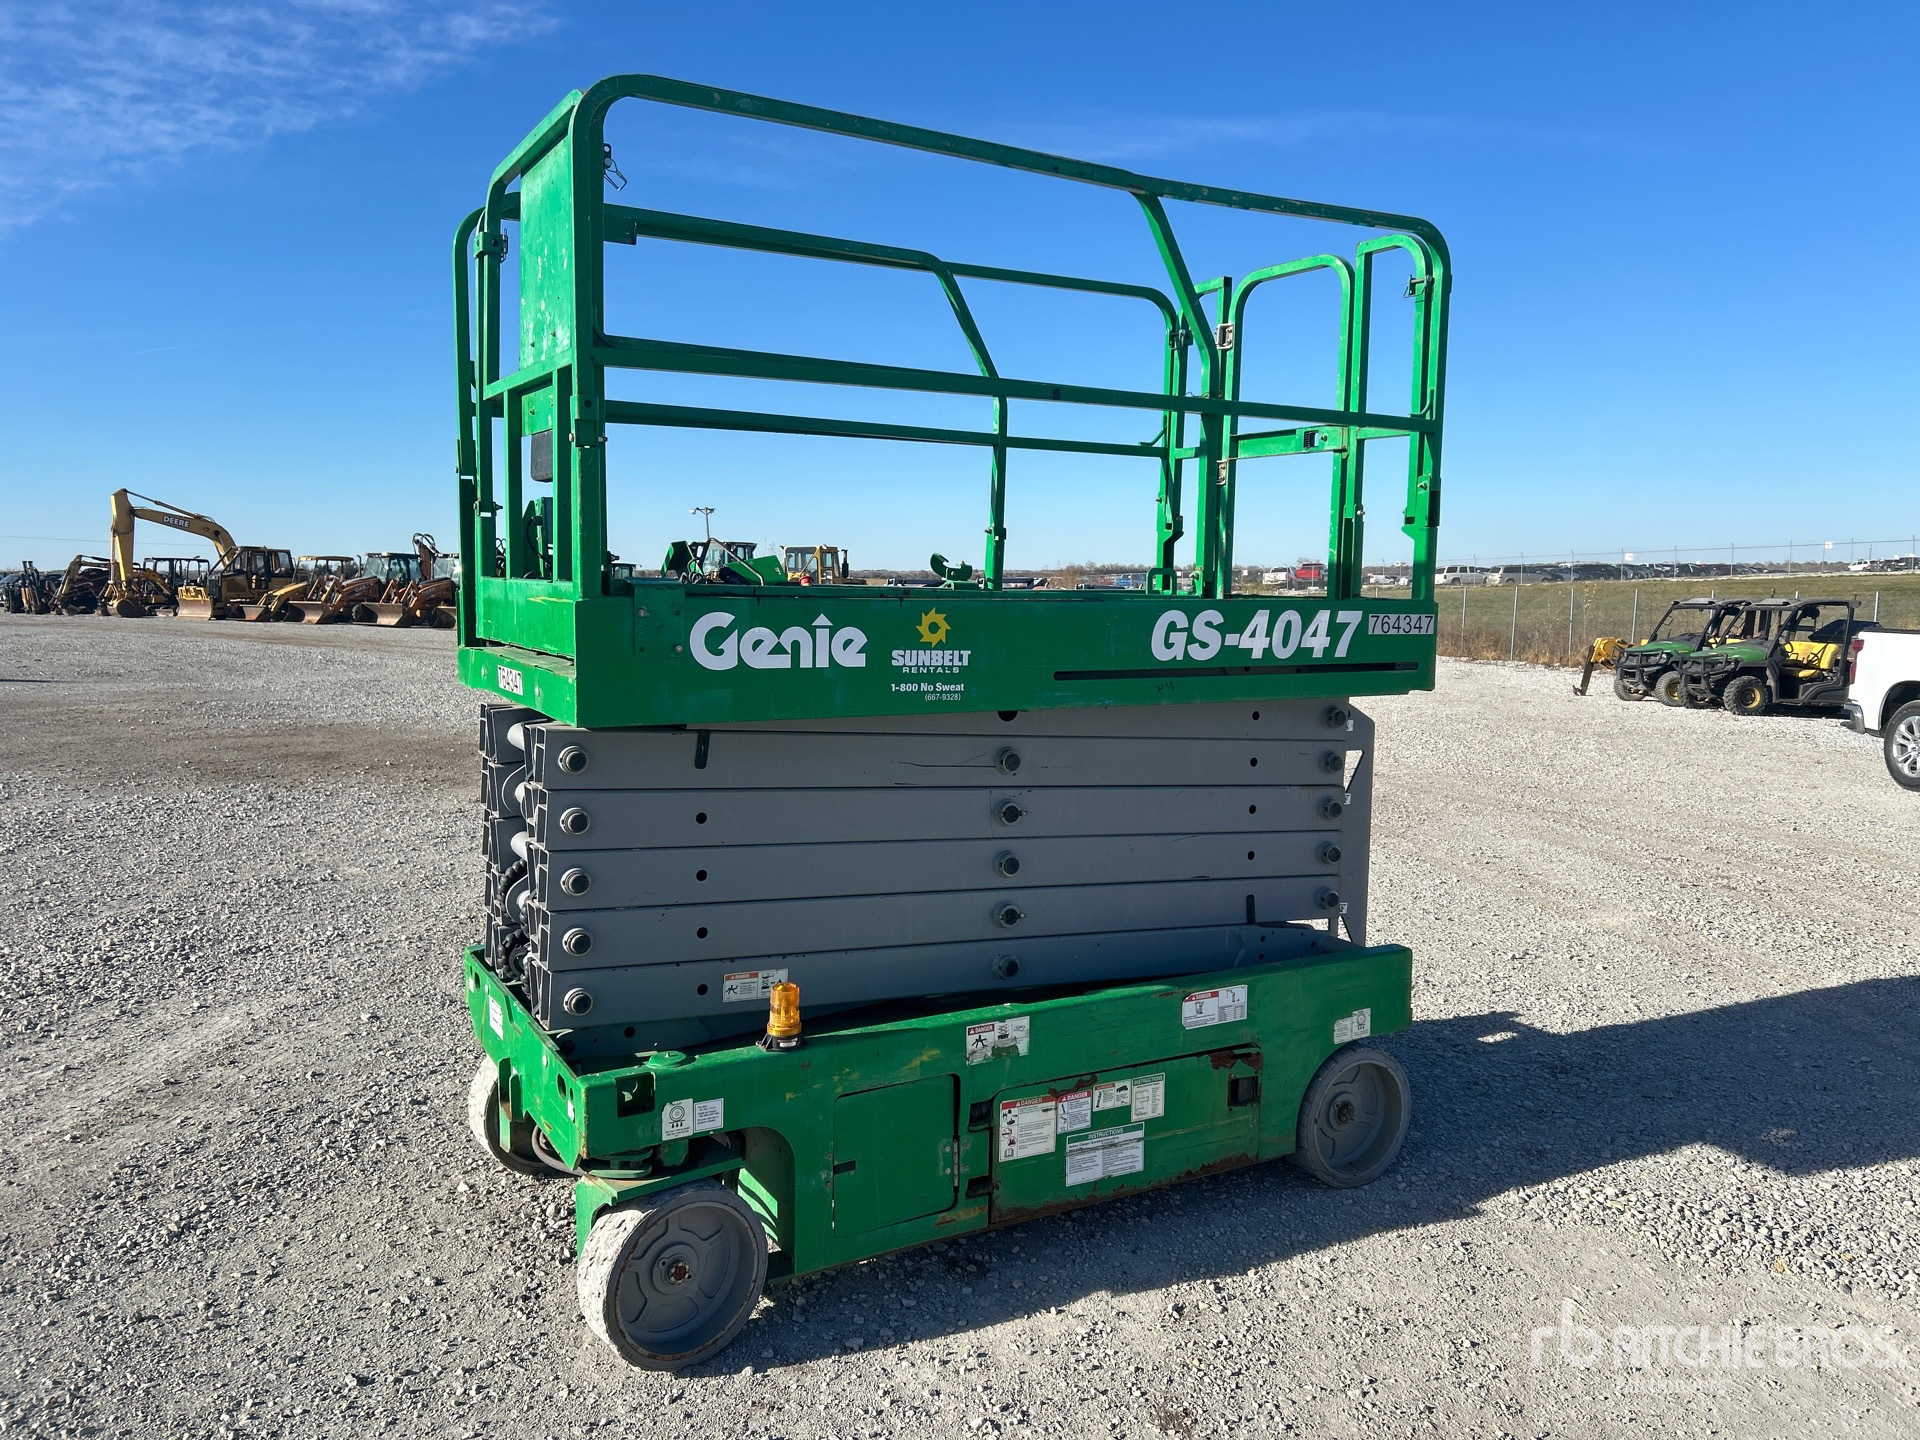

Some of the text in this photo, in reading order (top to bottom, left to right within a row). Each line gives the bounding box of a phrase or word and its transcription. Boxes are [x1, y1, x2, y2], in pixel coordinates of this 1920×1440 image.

[163, 515, 190, 528] DEERE
[1369, 615, 1434, 635] 764347
[689, 611, 868, 671] Genie
[1151, 609, 1363, 662] GS-4047
[891, 649, 972, 667] SUNBELT
[902, 666, 960, 674] RENTALS
[890, 682, 965, 692] 1-800 No Sweat
[924, 693, 961, 702] (667-9328)
[1020, 1097, 1043, 1107] DANGER
[1066, 1091, 1088, 1101] DANGER
[1087, 1128, 1124, 1140] INSTRUCTIONS
